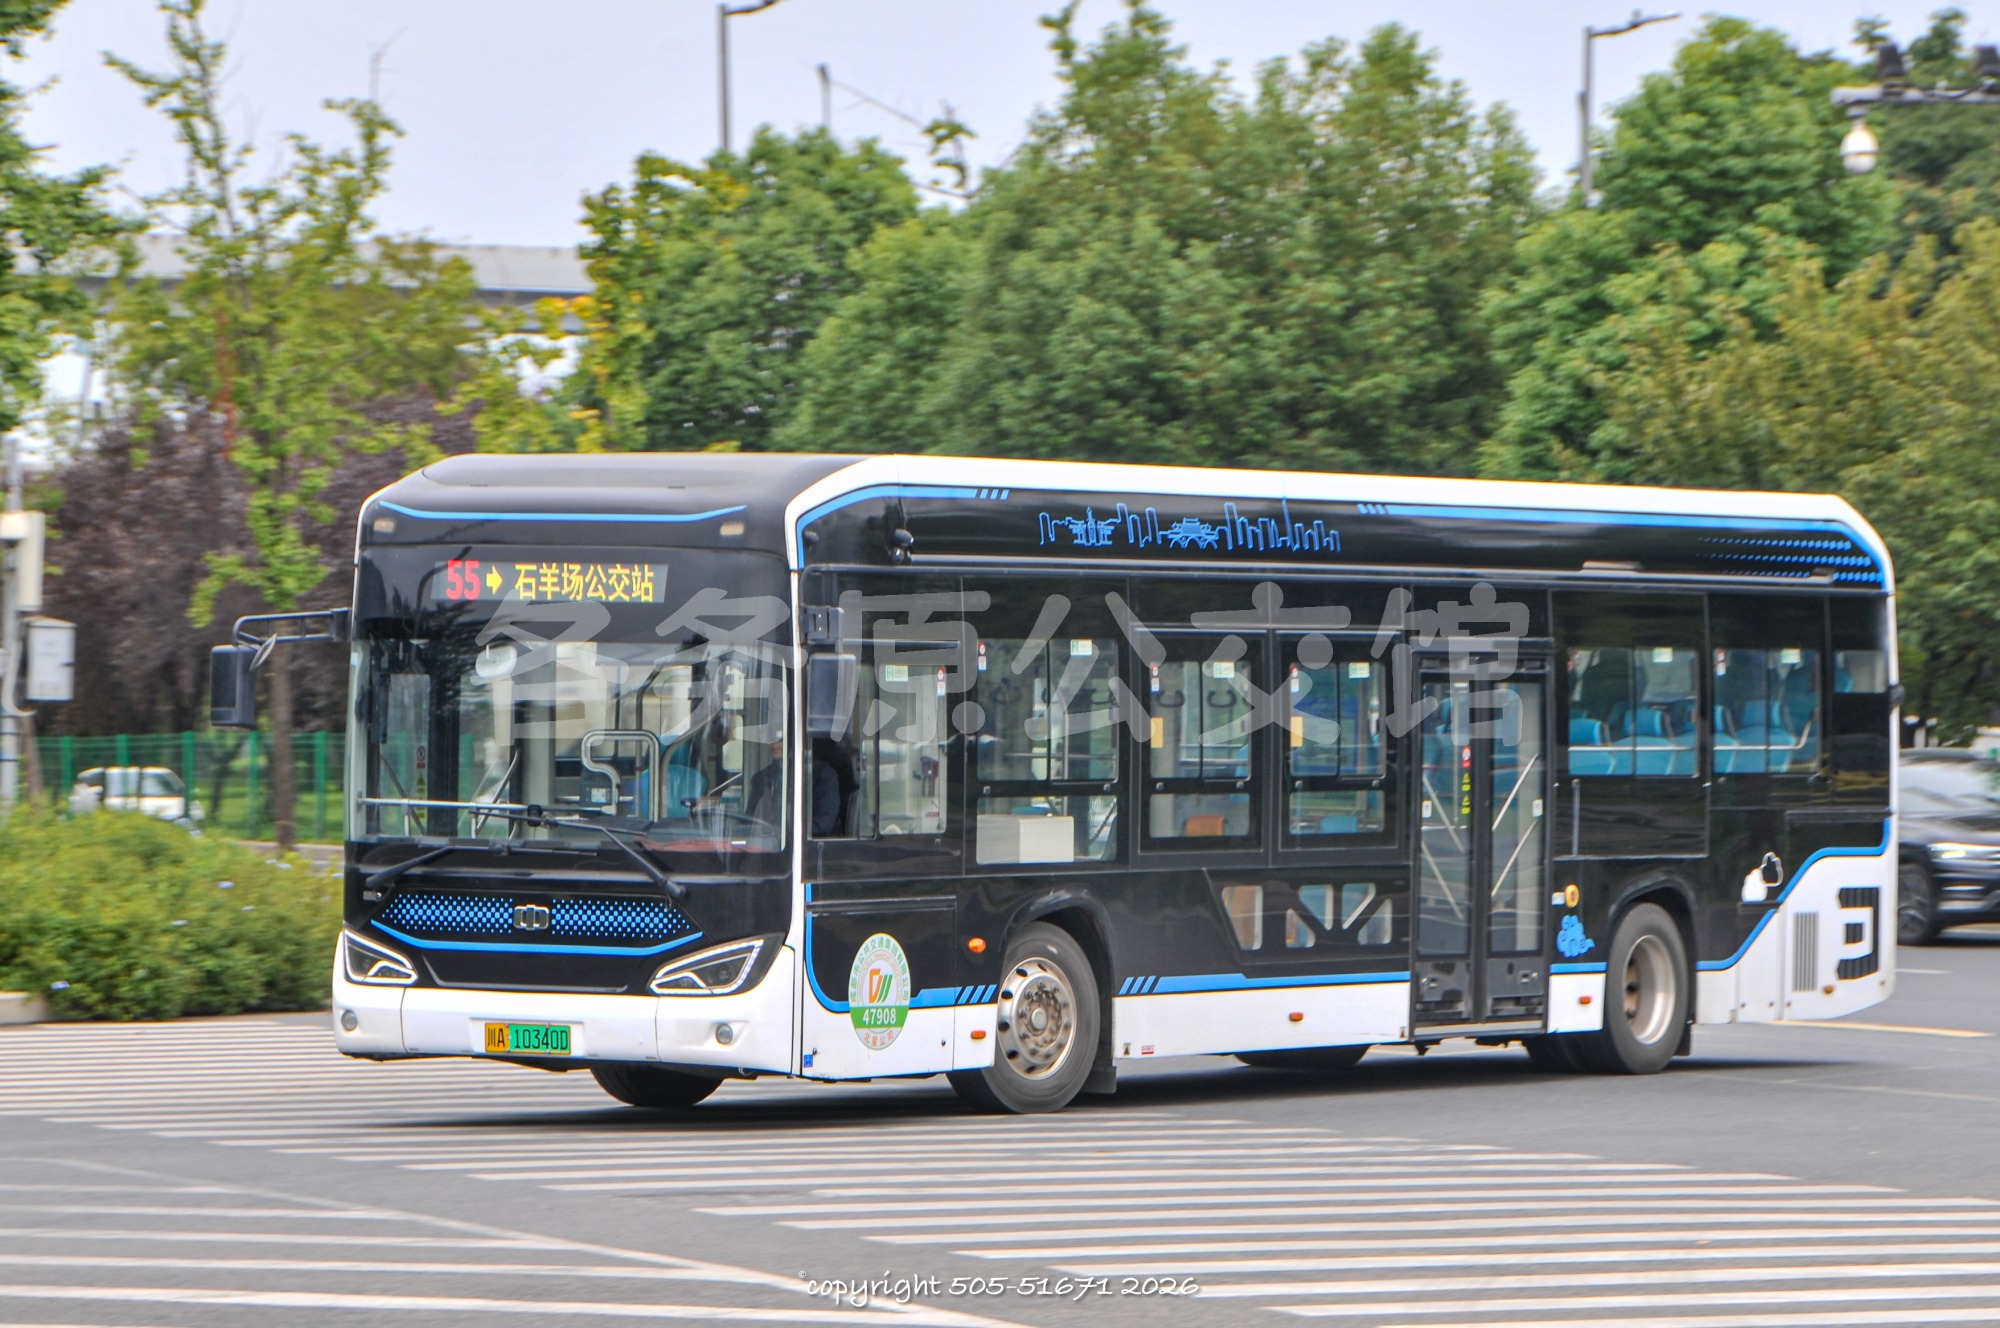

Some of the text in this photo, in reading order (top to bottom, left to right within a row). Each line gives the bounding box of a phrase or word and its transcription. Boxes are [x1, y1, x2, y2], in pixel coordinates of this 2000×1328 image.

[446, 559, 655, 603] 55 石羊场公交站
[862, 1008, 897, 1025] 47908
